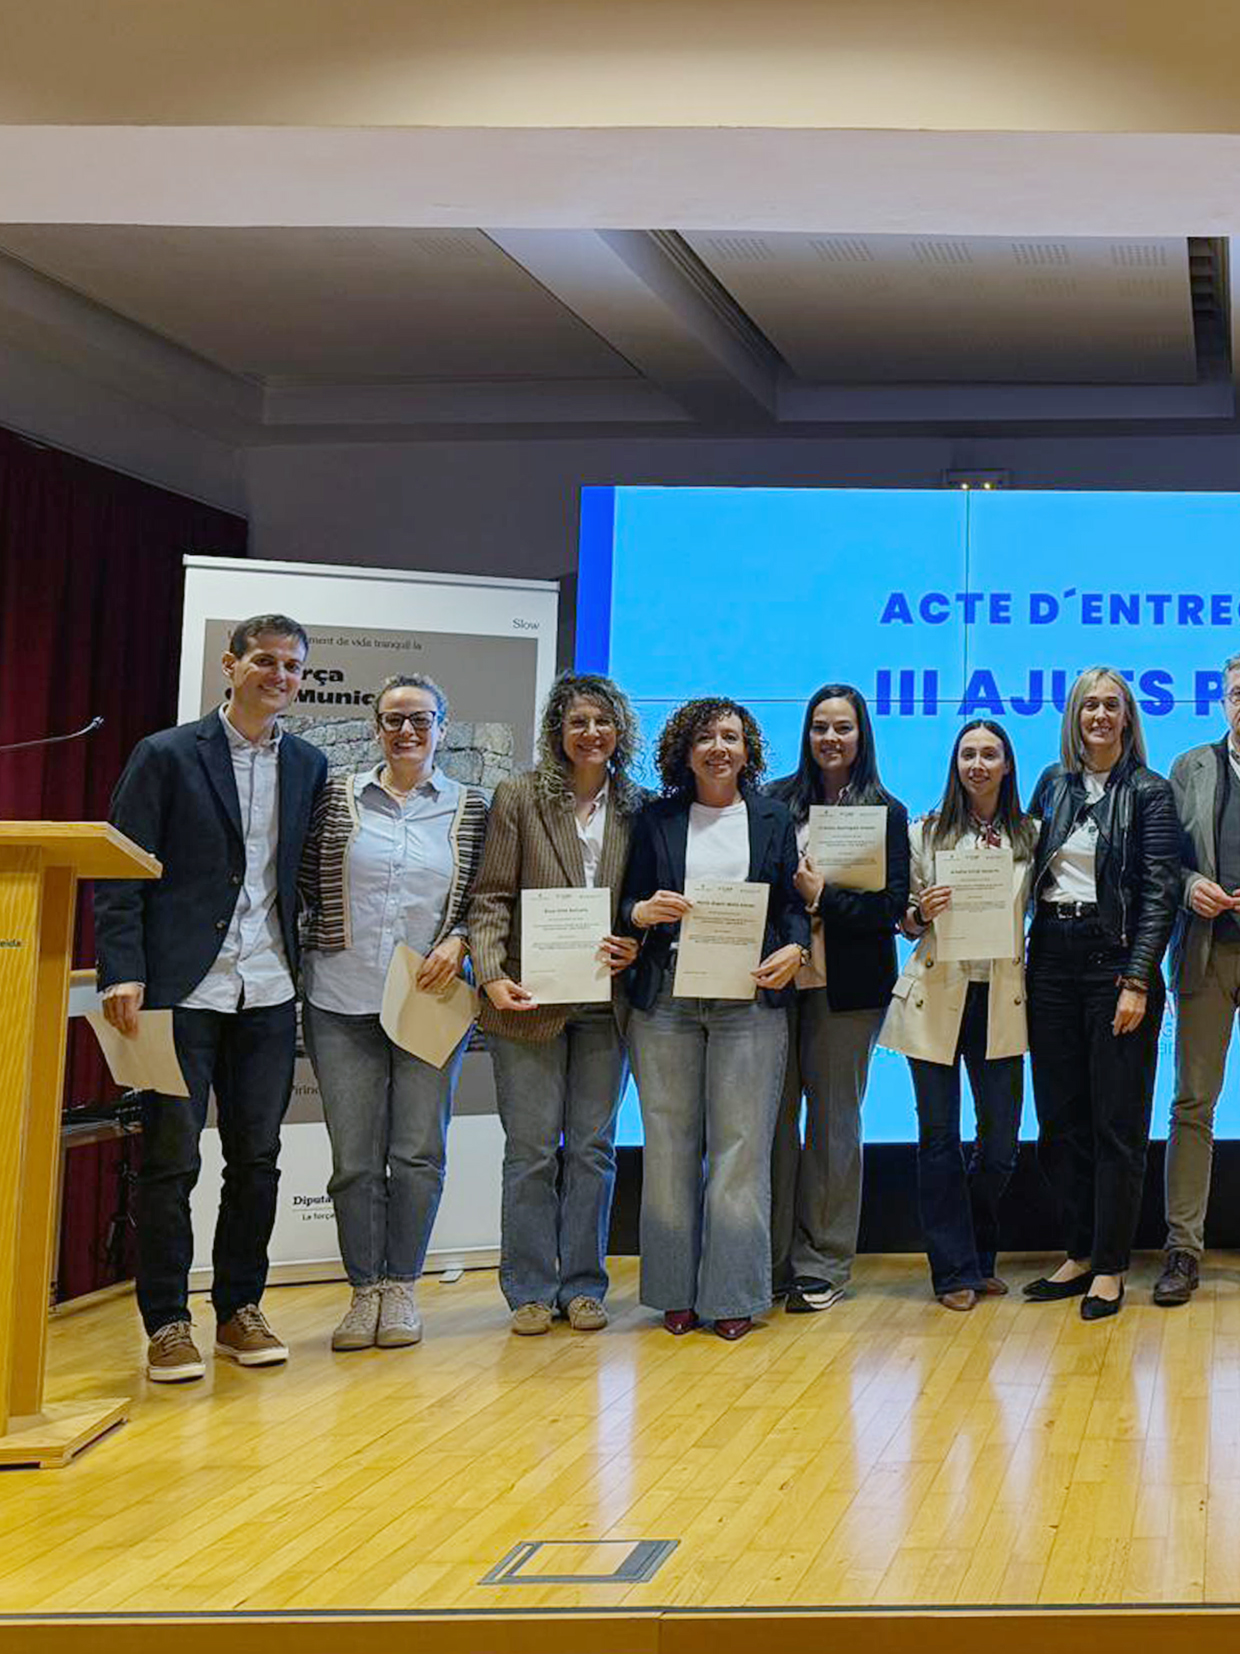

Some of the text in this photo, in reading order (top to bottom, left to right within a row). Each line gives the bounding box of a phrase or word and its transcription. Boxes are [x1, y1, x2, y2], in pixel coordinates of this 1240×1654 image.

[879, 592, 1012, 624] ACTE
[512, 618, 540, 630] Slow
[309, 636, 334, 646] ment
[301, 668, 344, 686] rça
[296, 688, 376, 705] Munic
[876, 669, 938, 717] III
[957, 669, 1174, 717] AJUS
[293, 1195, 332, 1207] Diputa
